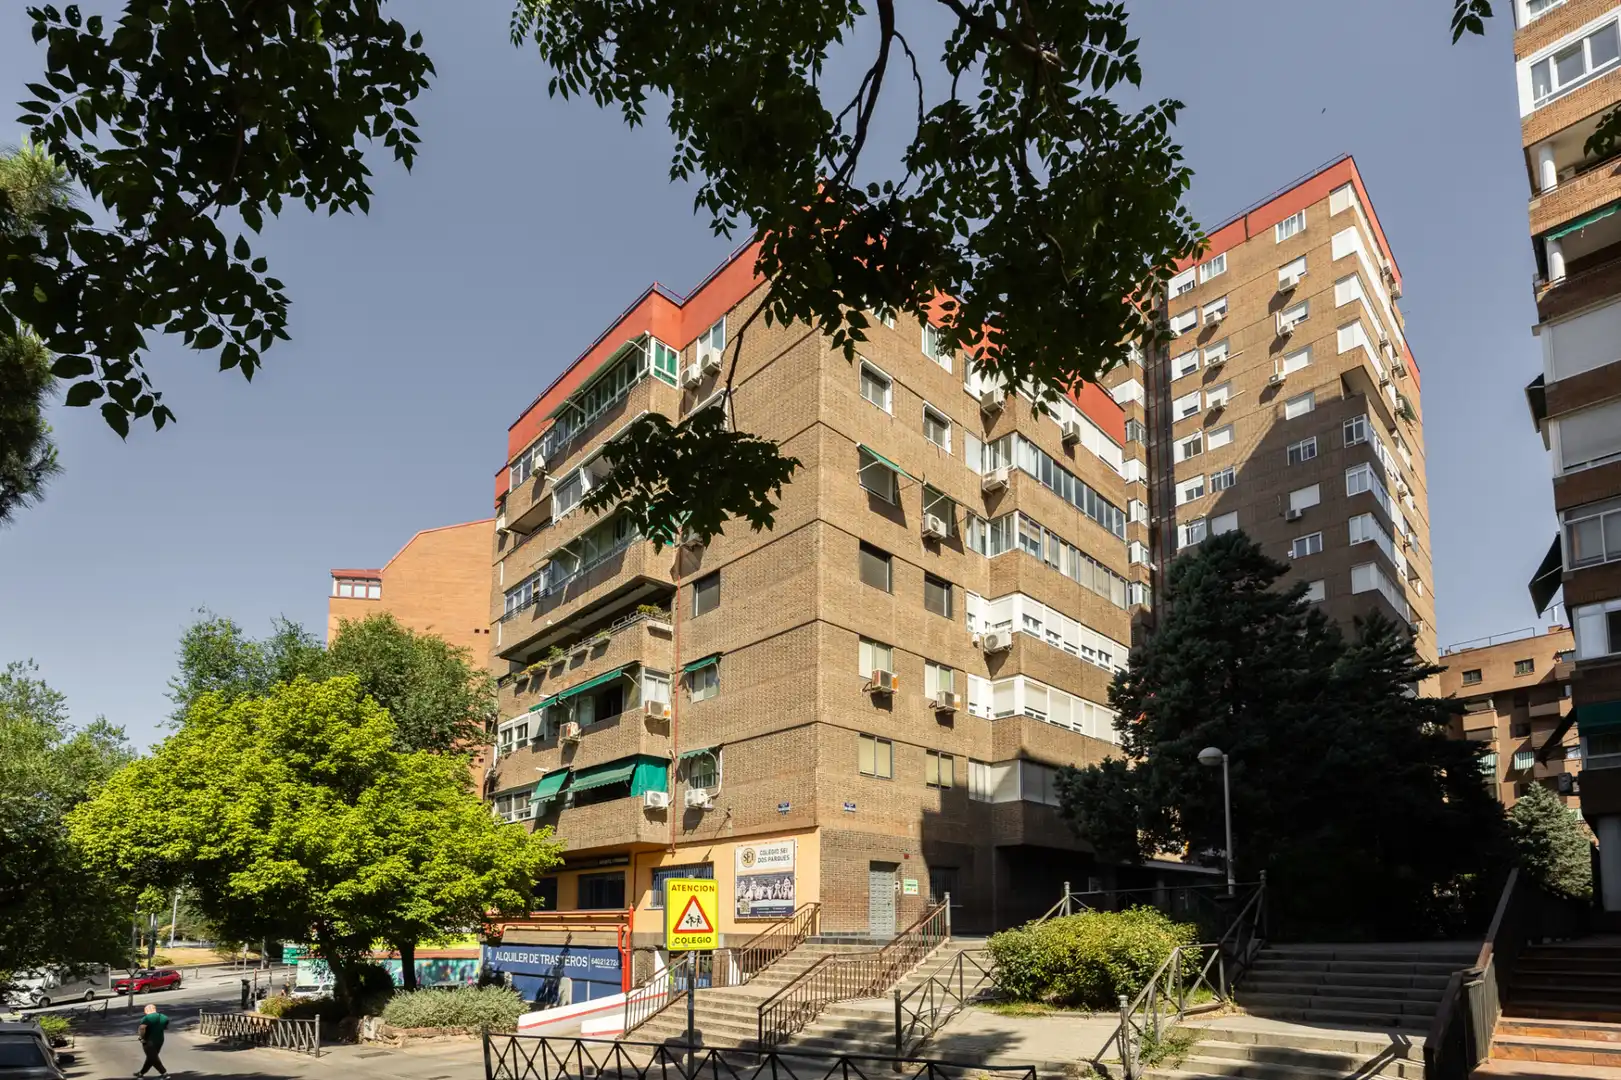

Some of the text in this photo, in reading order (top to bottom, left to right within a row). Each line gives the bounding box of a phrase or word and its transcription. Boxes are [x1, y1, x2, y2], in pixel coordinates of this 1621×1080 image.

[760, 848, 780, 856] COLEGIO
[768, 854, 790, 862] PARQUES
[672, 884, 715, 892] ATENCION
[674, 936, 712, 944] COLEGIO
[495, 951, 528, 963] ALQUILER
[529, 953, 540, 964] DE
[540, 954, 588, 968] TRASTEROS
